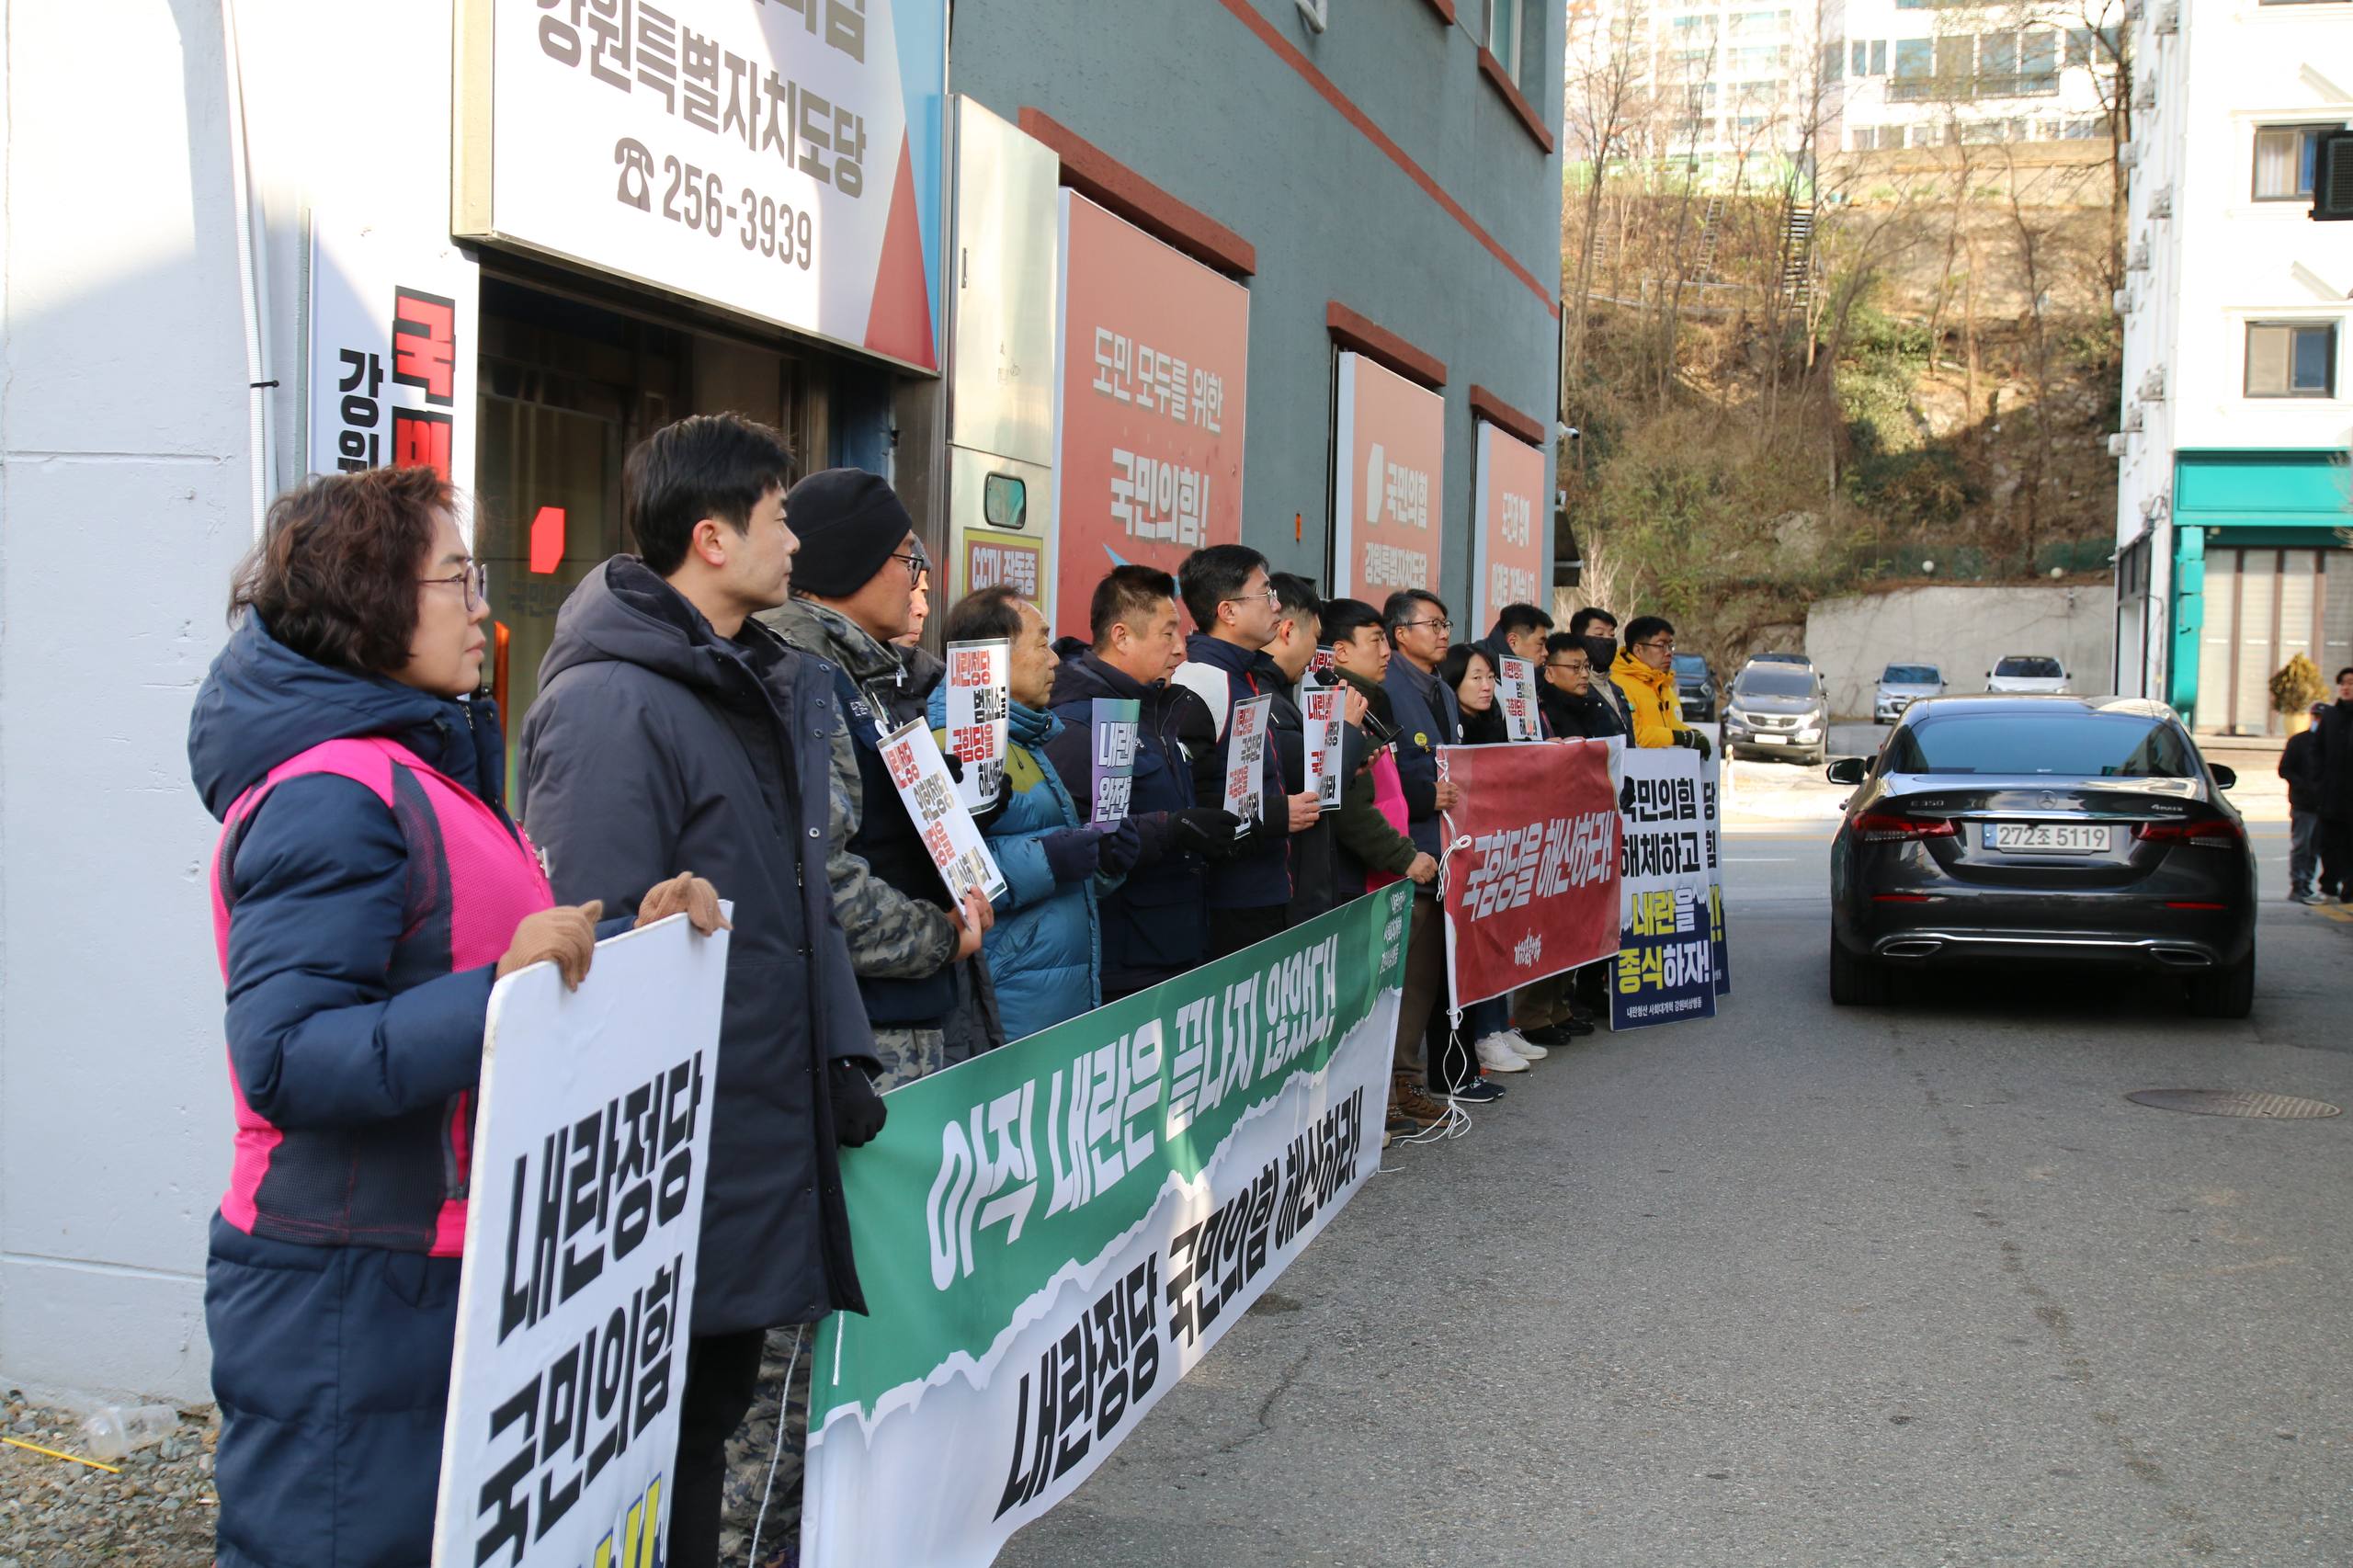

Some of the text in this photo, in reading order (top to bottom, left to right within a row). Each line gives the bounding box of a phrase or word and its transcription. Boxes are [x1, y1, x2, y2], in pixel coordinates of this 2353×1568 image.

[663, 154, 812, 271] 256-3939
[1093, 326, 1223, 434] 도민 모두를 위한
[1110, 448, 1210, 549] 국민의힘!
[1386, 461, 1428, 529] 국민의힘
[972, 546, 1002, 590] CCTV
[950, 650, 991, 687] 내란정당
[952, 723, 994, 763] 국힘당을
[913, 770, 955, 825] 위헌정당
[1461, 822, 1544, 923] 국힘당을
[1535, 810, 1616, 899] 해산하라!
[1621, 832, 1700, 878] 해체하고
[1999, 826, 2106, 846] 272조 5119
[1632, 885, 1696, 937] 내란을
[1618, 939, 1711, 994] 종식하자!
[926, 932, 1340, 1291] 아직 내란은 끝나지 않았다!
[496, 1049, 703, 1347] 내란정당
[992, 1085, 1364, 1523] 내란정당 국민의힘 해산하라!
[472, 1251, 684, 1568] 국민의힘
